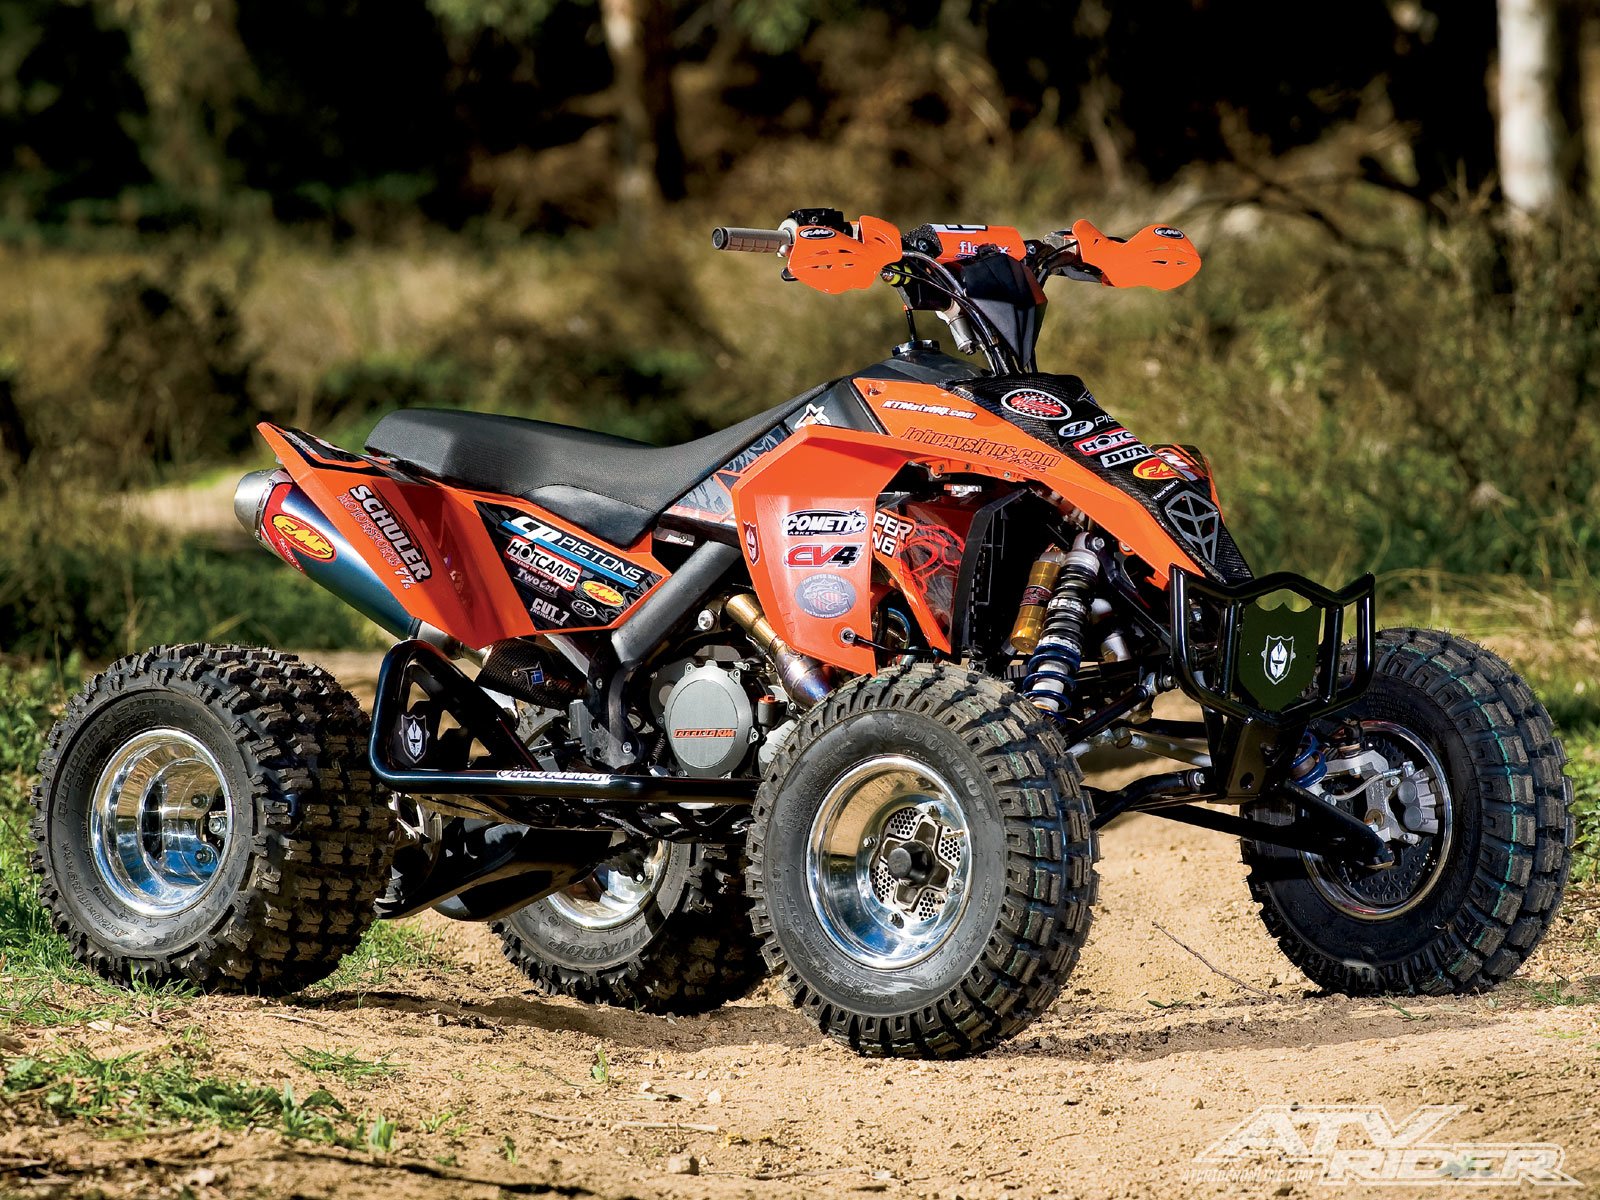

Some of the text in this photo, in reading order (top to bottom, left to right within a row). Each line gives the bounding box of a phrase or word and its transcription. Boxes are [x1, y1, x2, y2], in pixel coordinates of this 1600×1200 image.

[273, 516, 334, 555] FMF
[350, 484, 431, 580] SCHULER
[782, 513, 867, 533] COMETIC
[507, 516, 563, 545] CP
[558, 536, 645, 582] PISTONS
[786, 545, 862, 568] CV4
[532, 597, 560, 617] CUT
[560, 610, 570, 624] 7
